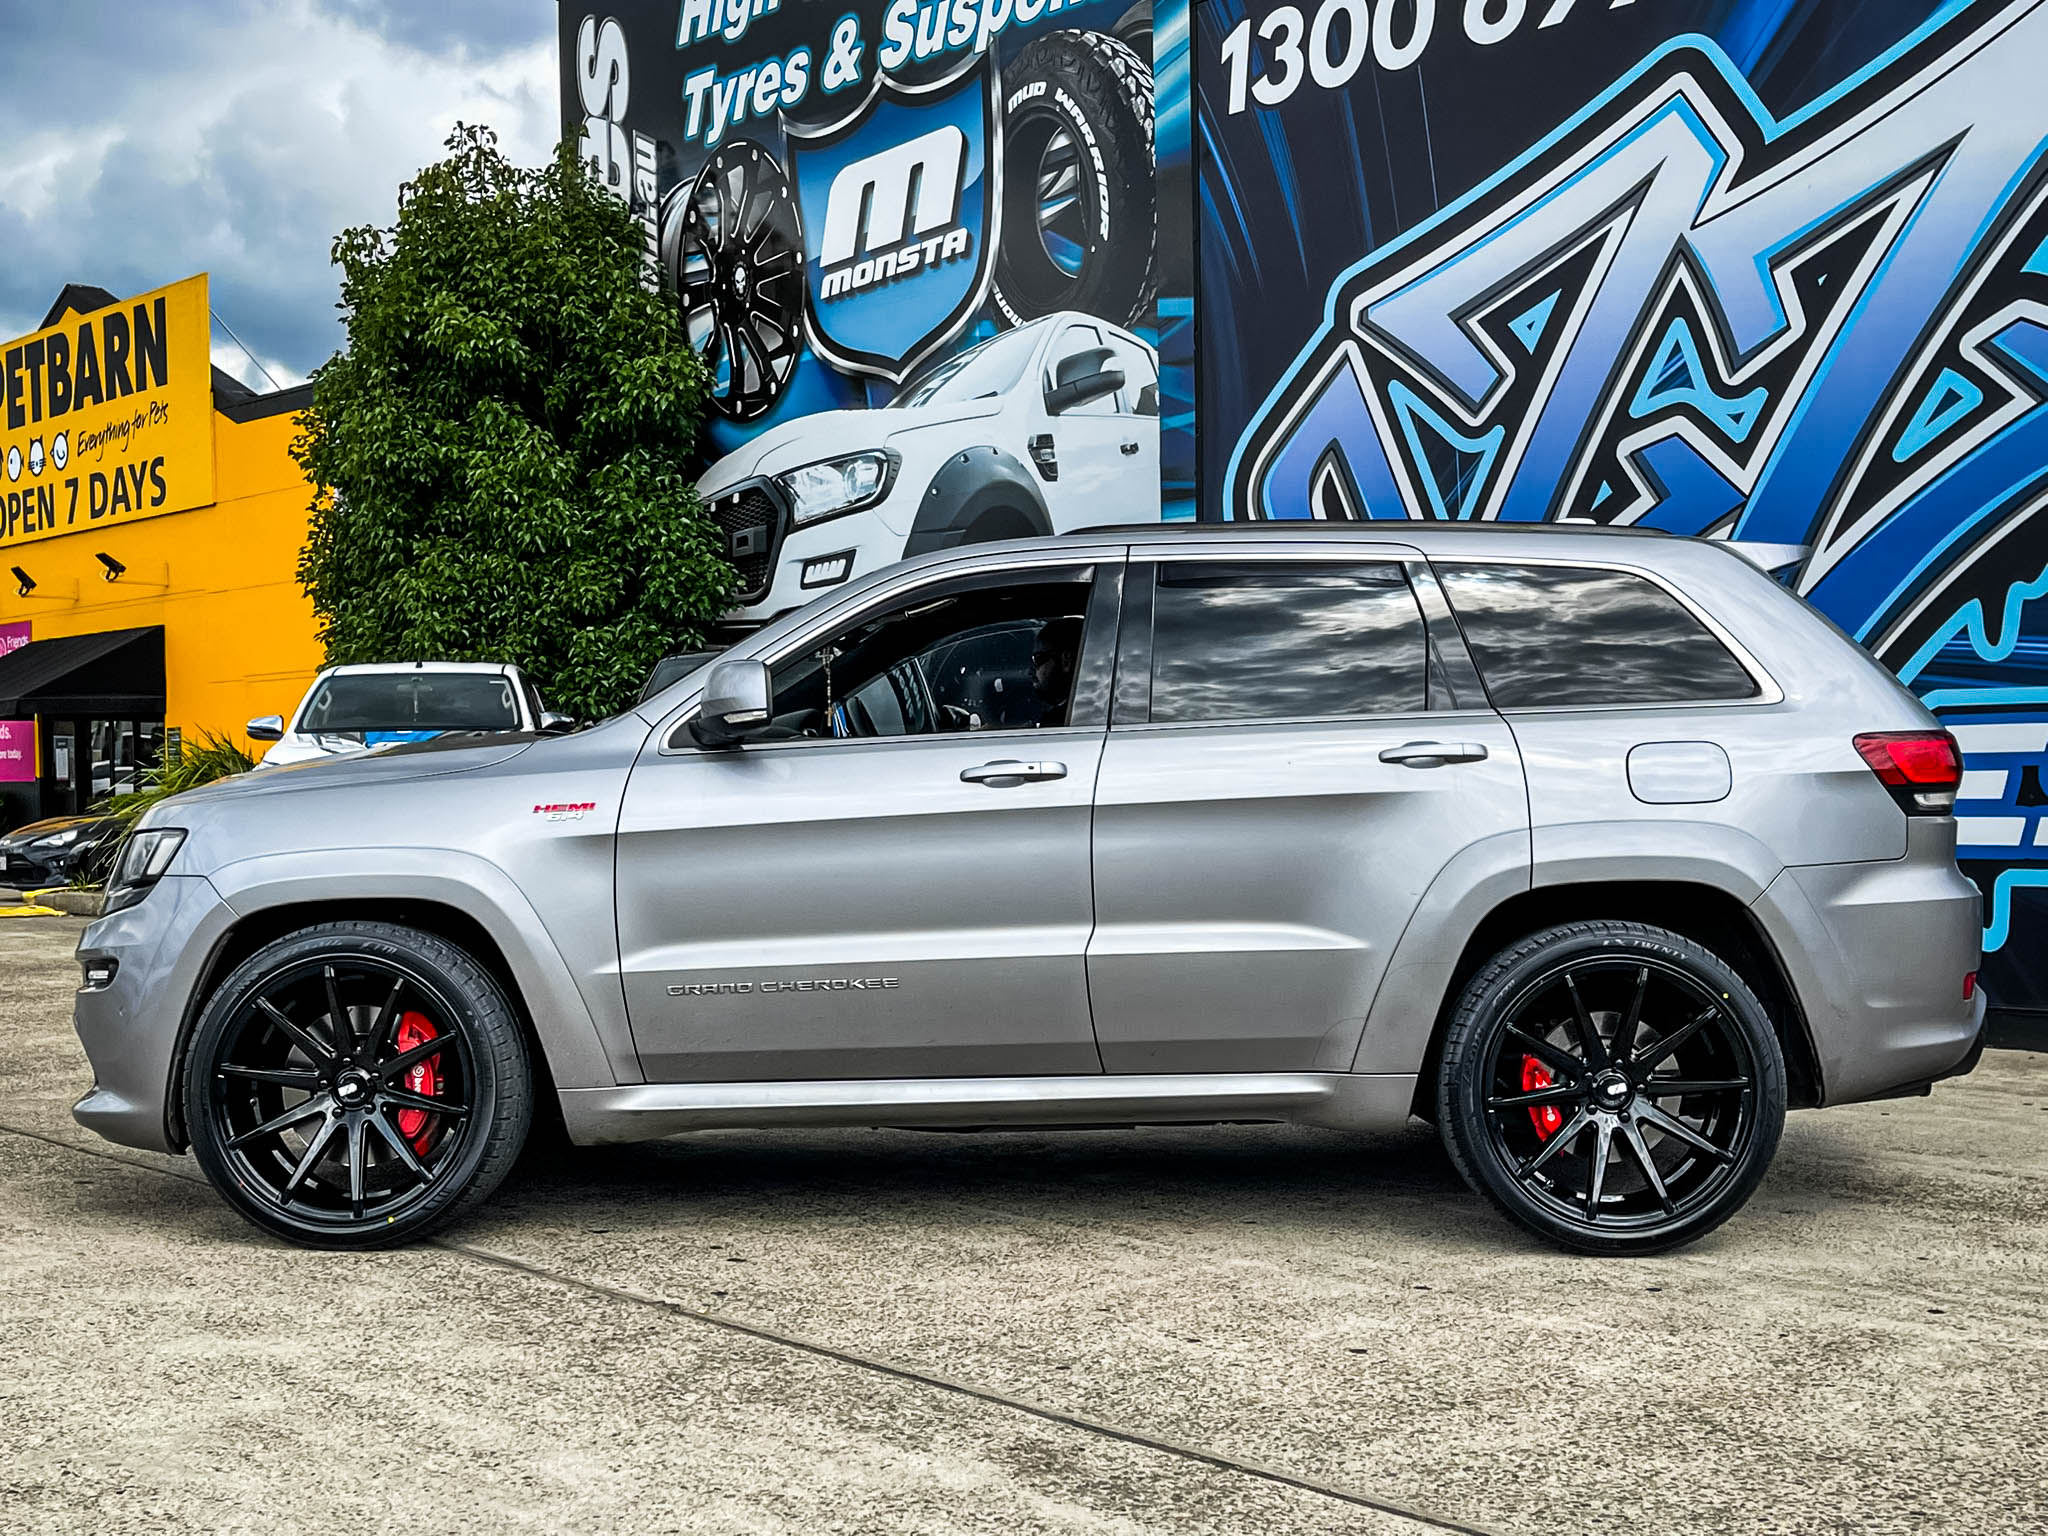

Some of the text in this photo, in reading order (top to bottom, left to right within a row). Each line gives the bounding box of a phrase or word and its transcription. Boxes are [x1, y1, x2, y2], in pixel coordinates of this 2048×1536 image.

[685, 51, 809, 144] Tyres
[824, 18, 862, 90] &
[1221, 0, 1436, 115] 1300
[1008, 81, 1110, 241] MUD WARRIOR
[0, 296, 168, 431] ETBARN
[77, 400, 168, 463] Everything for Pets
[65, 477, 79, 525] 7
[89, 456, 167, 519] DAYS
[533, 802, 596, 813] HEMI
[666, 977, 900, 996] GRAND CHEROKEE
